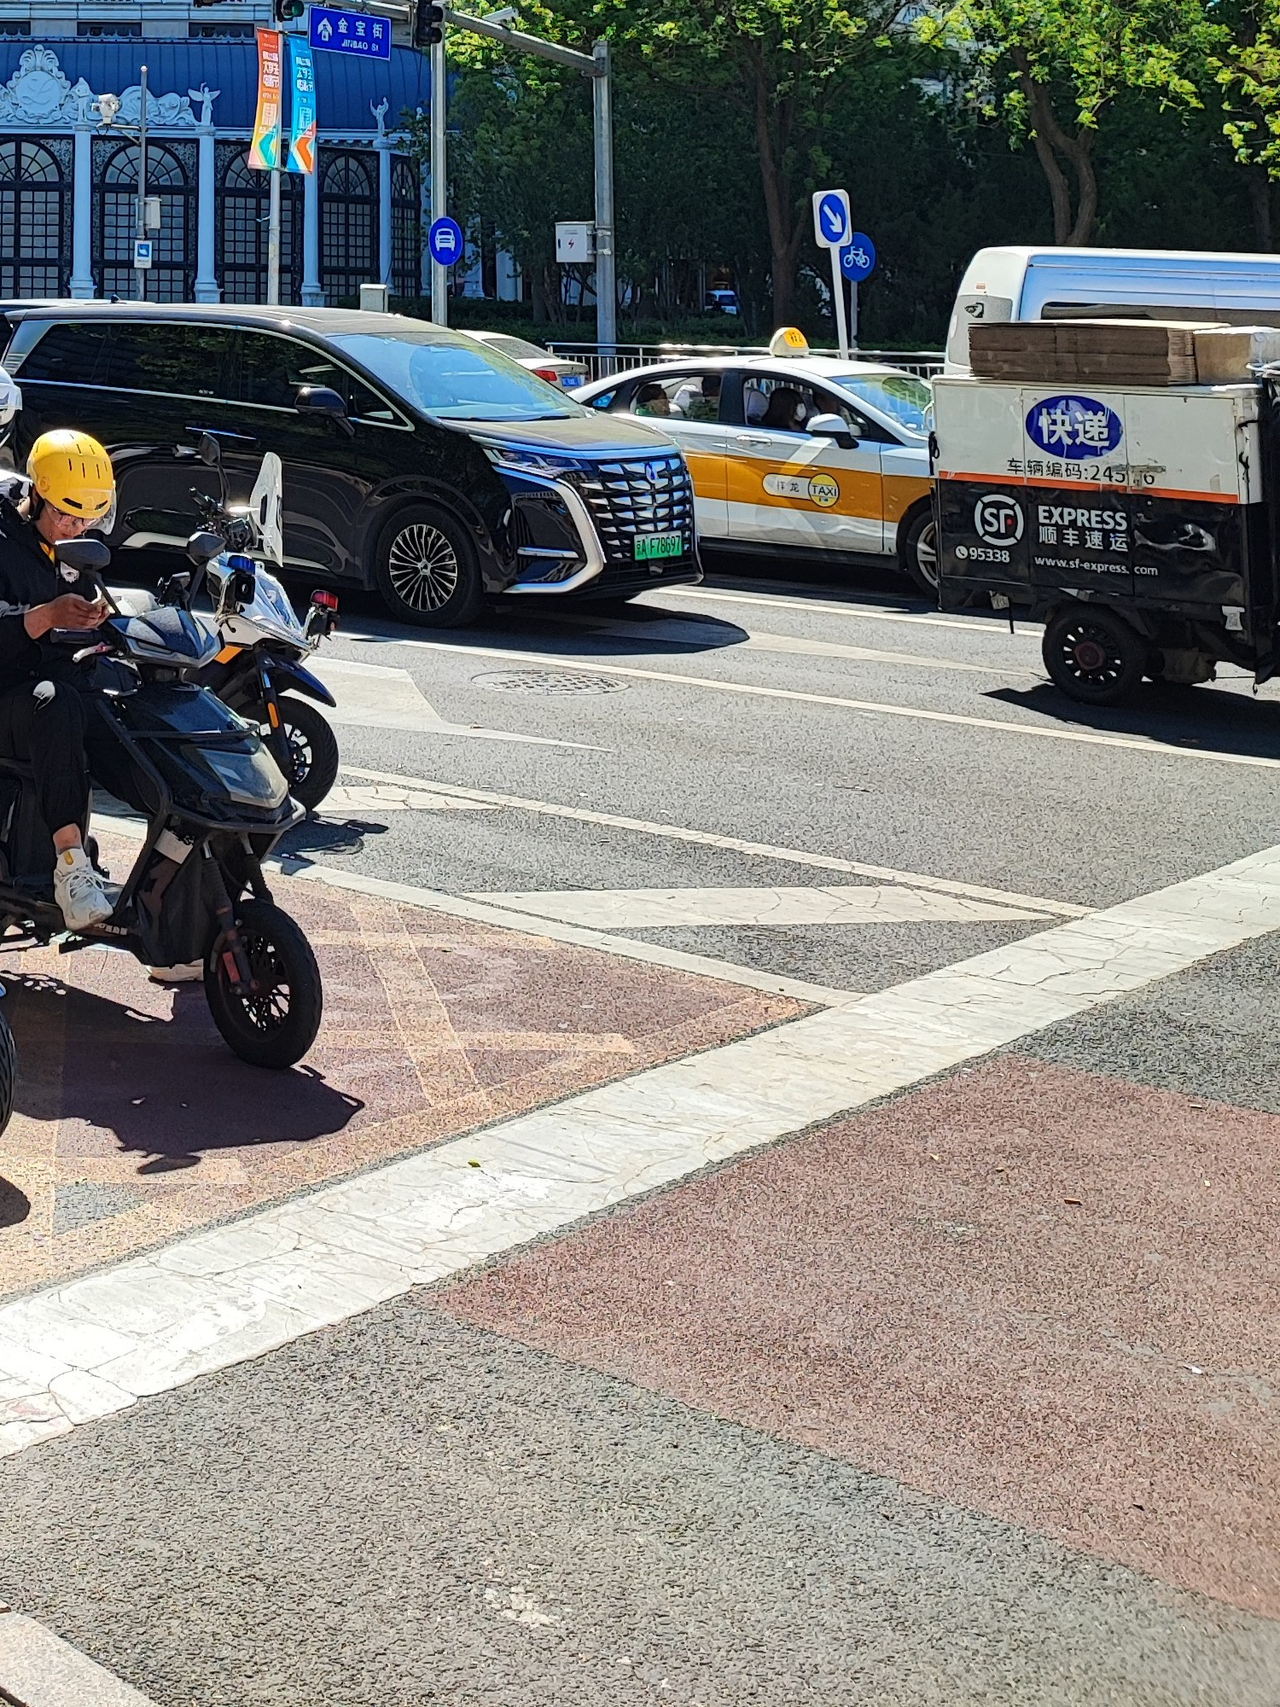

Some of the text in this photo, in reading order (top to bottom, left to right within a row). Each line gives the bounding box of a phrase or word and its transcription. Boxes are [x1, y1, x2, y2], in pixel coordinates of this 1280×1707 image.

[338, 17, 383, 39] 金宝街
[1038, 407, 1110, 446] 快递
[812, 484, 837, 497] TAXI
[983, 507, 1015, 534] SF
[1038, 505, 1128, 531] EXPRESS
[1039, 525, 1129, 552] 顺丰速运
[969, 547, 1011, 564] 95338
